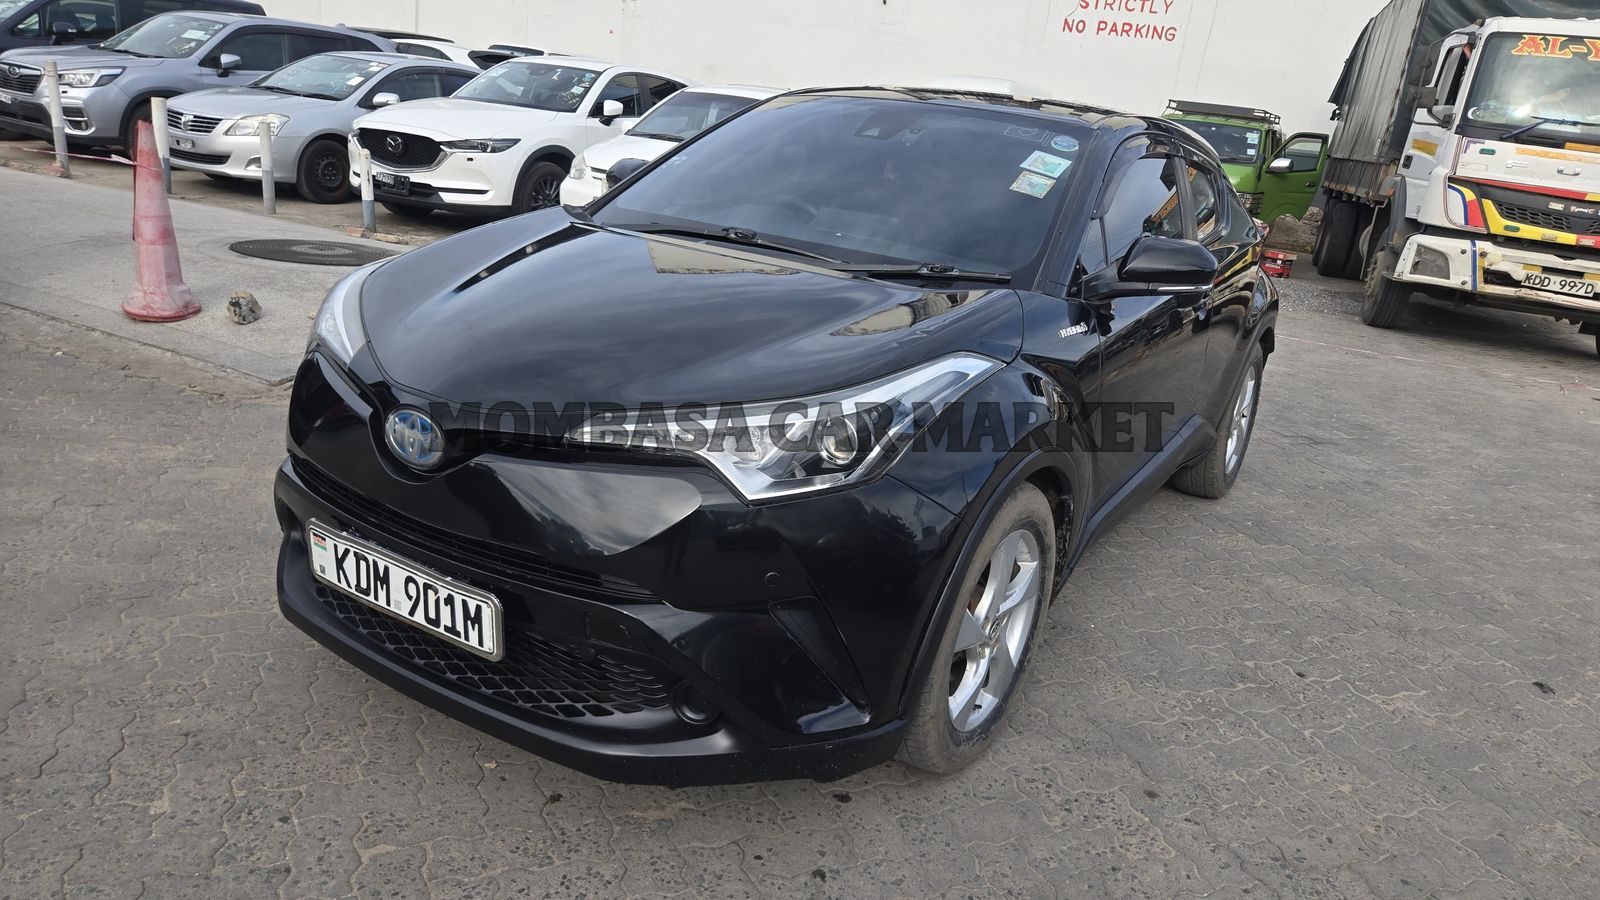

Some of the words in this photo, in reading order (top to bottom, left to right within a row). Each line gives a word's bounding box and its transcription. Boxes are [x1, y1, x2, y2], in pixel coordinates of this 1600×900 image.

[1079, 0, 1174, 14] STRICTLY
[1062, 18, 1087, 33] NO
[1096, 20, 1178, 42] PARKING
[1523, 273, 1551, 288] KDD
[1559, 279, 1595, 295] 997D
[333, 542, 391, 608] KDM
[404, 575, 485, 648] 901M
